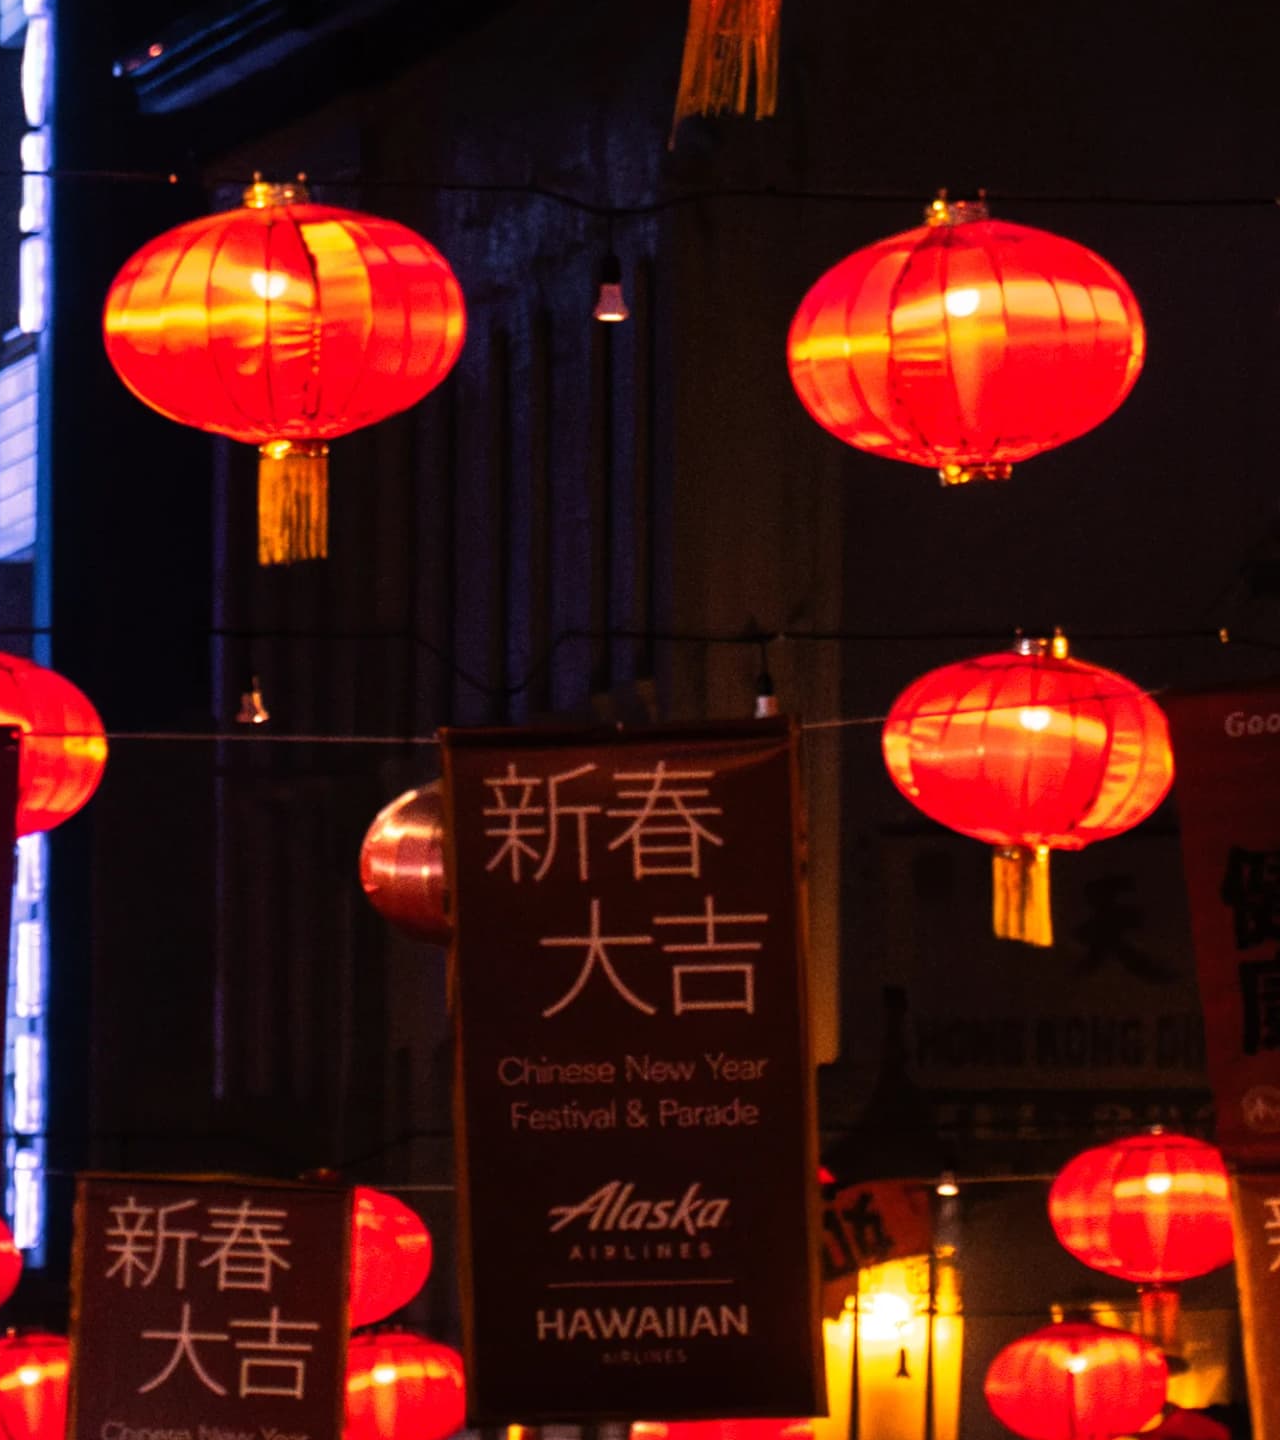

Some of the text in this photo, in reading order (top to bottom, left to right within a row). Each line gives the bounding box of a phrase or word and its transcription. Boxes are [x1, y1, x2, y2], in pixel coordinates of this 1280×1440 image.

[481, 760, 726, 884] 新春
[537, 893, 770, 1019] 大吉
[497, 1049, 771, 1087] Chinese New Year
[510, 1095, 761, 1134] Festival & Parade
[546, 1178, 734, 1238] Alaska
[103, 1193, 293, 1293] 新春
[568, 1239, 714, 1263] AIRLINES
[136, 1300, 321, 1401] 大吉
[535, 1304, 752, 1342] HAWAIIAN
